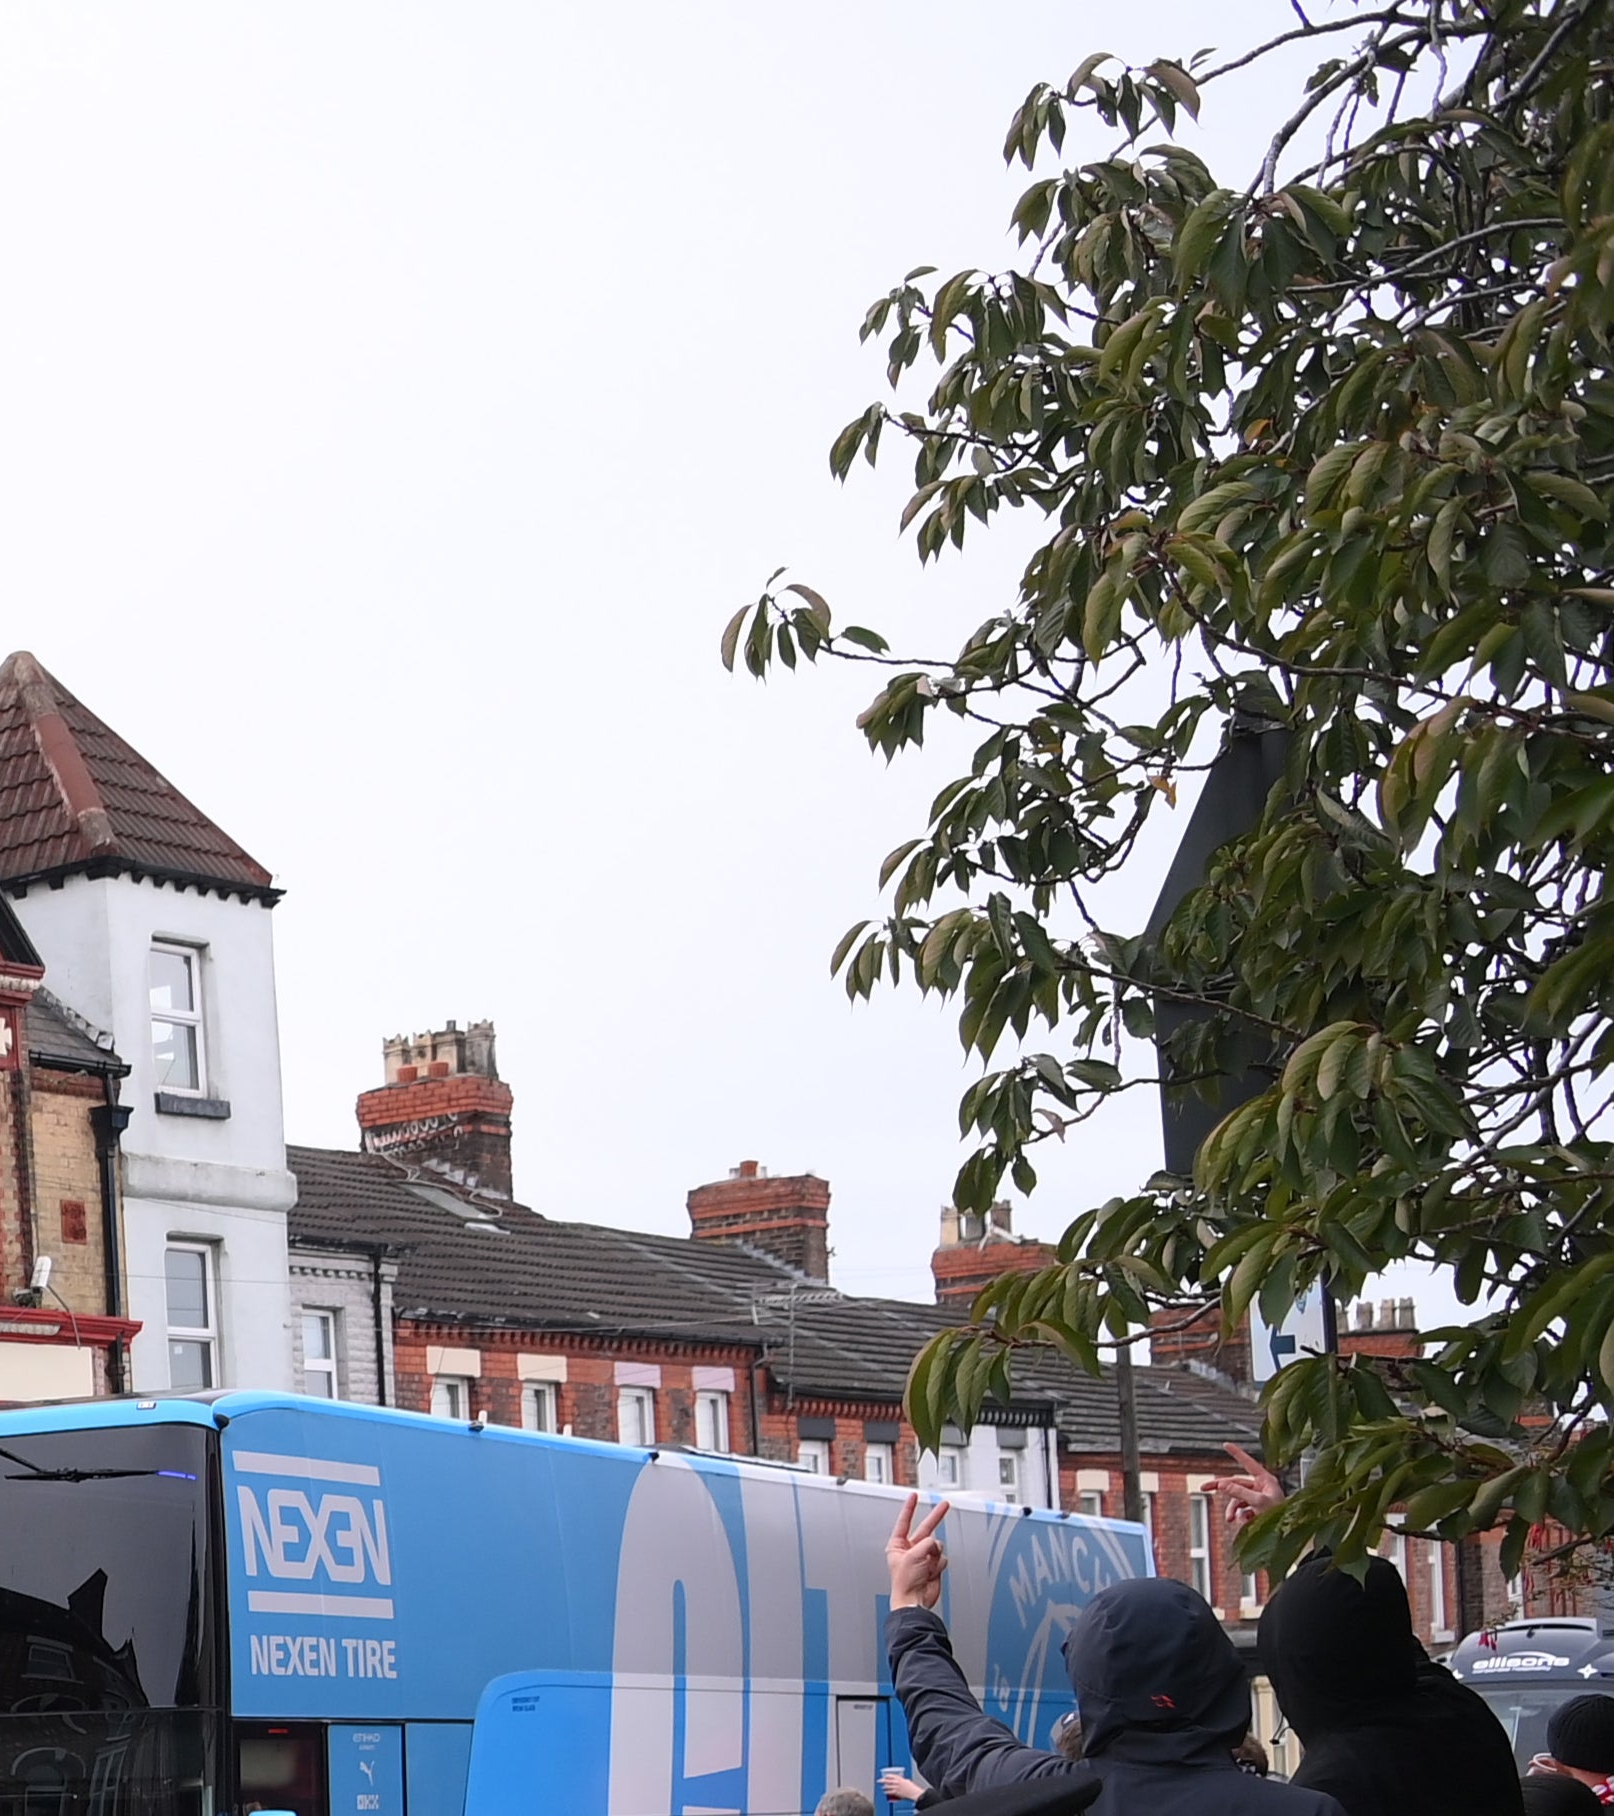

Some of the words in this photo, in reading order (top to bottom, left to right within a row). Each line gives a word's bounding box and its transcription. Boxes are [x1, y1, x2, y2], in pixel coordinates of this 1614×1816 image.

[236, 1485, 392, 1586] NEXEN
[250, 1634, 337, 1677] NEXEN
[341, 1639, 398, 1679] TIRE
